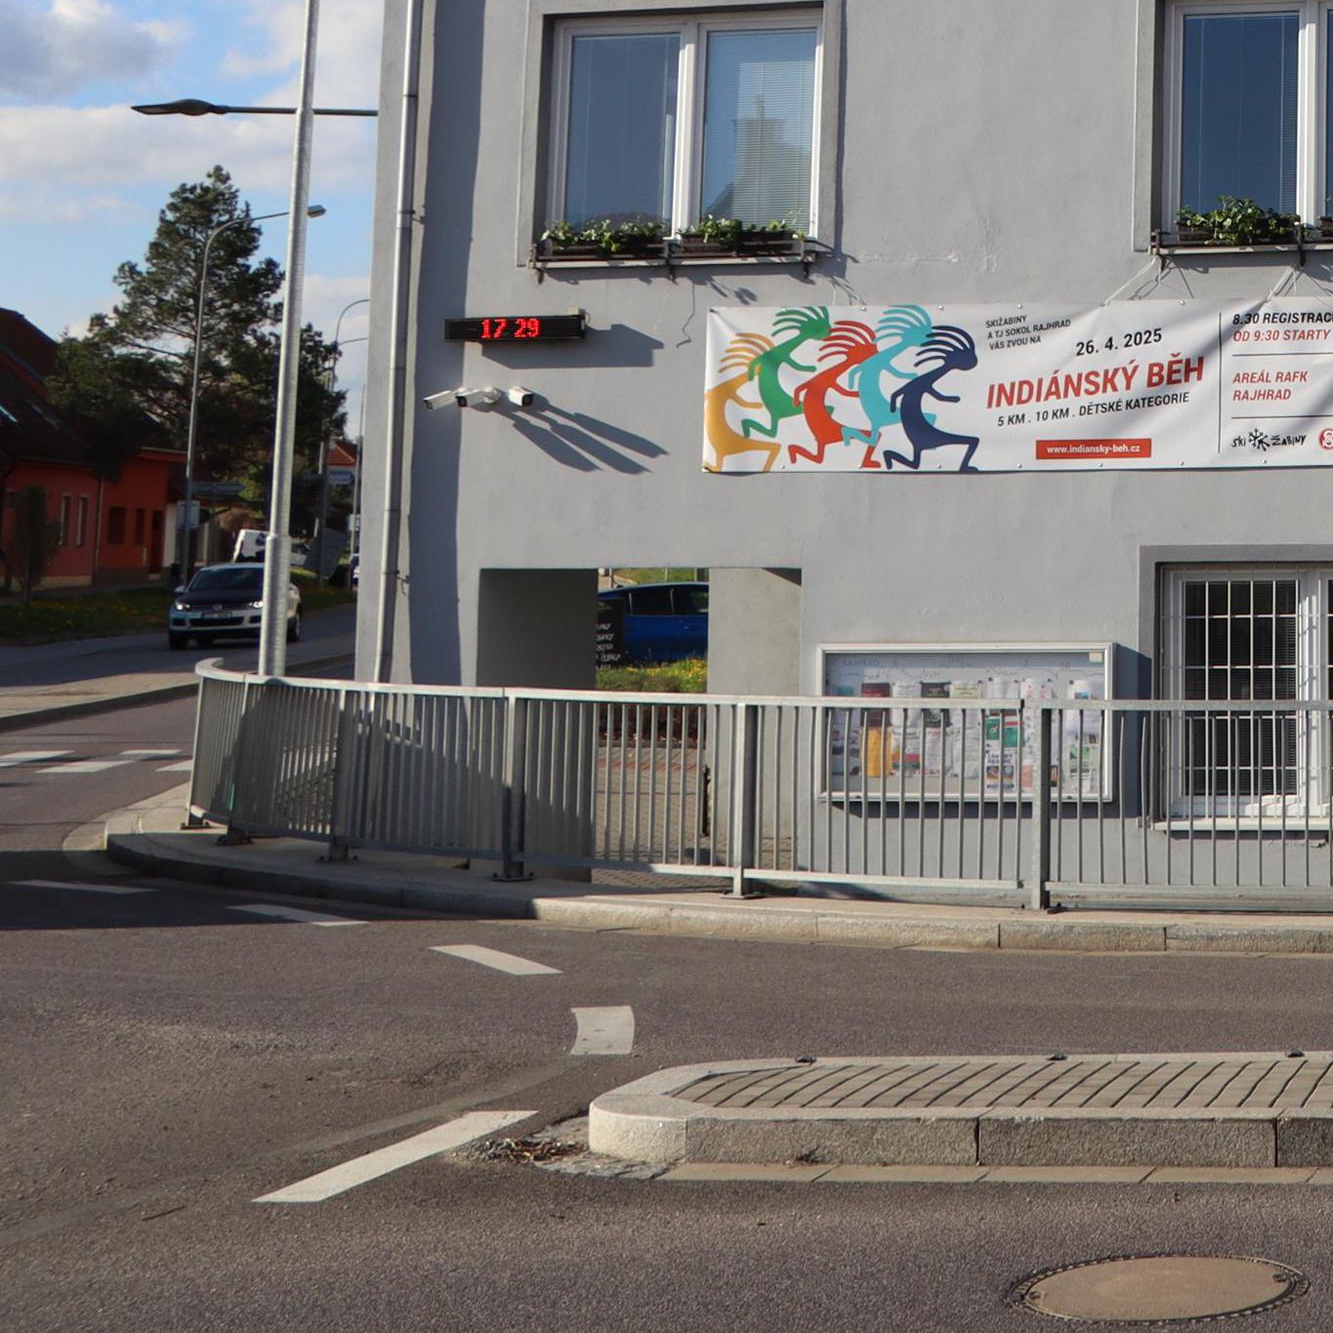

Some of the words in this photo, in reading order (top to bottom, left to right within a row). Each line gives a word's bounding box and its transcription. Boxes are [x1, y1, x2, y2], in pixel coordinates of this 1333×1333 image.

[481, 318, 507, 339] 17
[514, 318, 540, 338] 29
[985, 314, 1027, 328] SKIŽABINY
[987, 331, 993, 339] A
[995, 329, 1004, 338] TJ
[1005, 327, 1031, 337] SOKOL
[1033, 319, 1071, 332] RAJHRAD
[1232, 330, 1250, 342] OD
[1253, 330, 1280, 341] 9:30
[1282, 329, 1331, 341] STARTY
[989, 338, 1005, 350] VÁS
[1007, 336, 1028, 348] ZVOU
[1029, 335, 1041, 344] NA
[1076, 339, 1099, 356] 26.
[1104, 336, 1118, 351] 4.
[1123, 328, 1163, 348] 2025
[986, 359, 1139, 409] INDIÁNSKÝ
[1146, 352, 1205, 389] BĚH
[1232, 369, 1272, 384] AREÁL
[1275, 371, 1309, 383] RAFK
[1232, 388, 1291, 401] RAJHRAD
[997, 416, 1005, 427] 5
[1007, 413, 1025, 426] KM
[1035, 410, 1049, 422] 10
[1051, 407, 1069, 420] KM
[1079, 400, 1122, 417] DĚTSKÉ
[1125, 391, 1190, 411] KATEGORIE
[1046, 443, 1141, 455] www.indiansky-beh.cz
